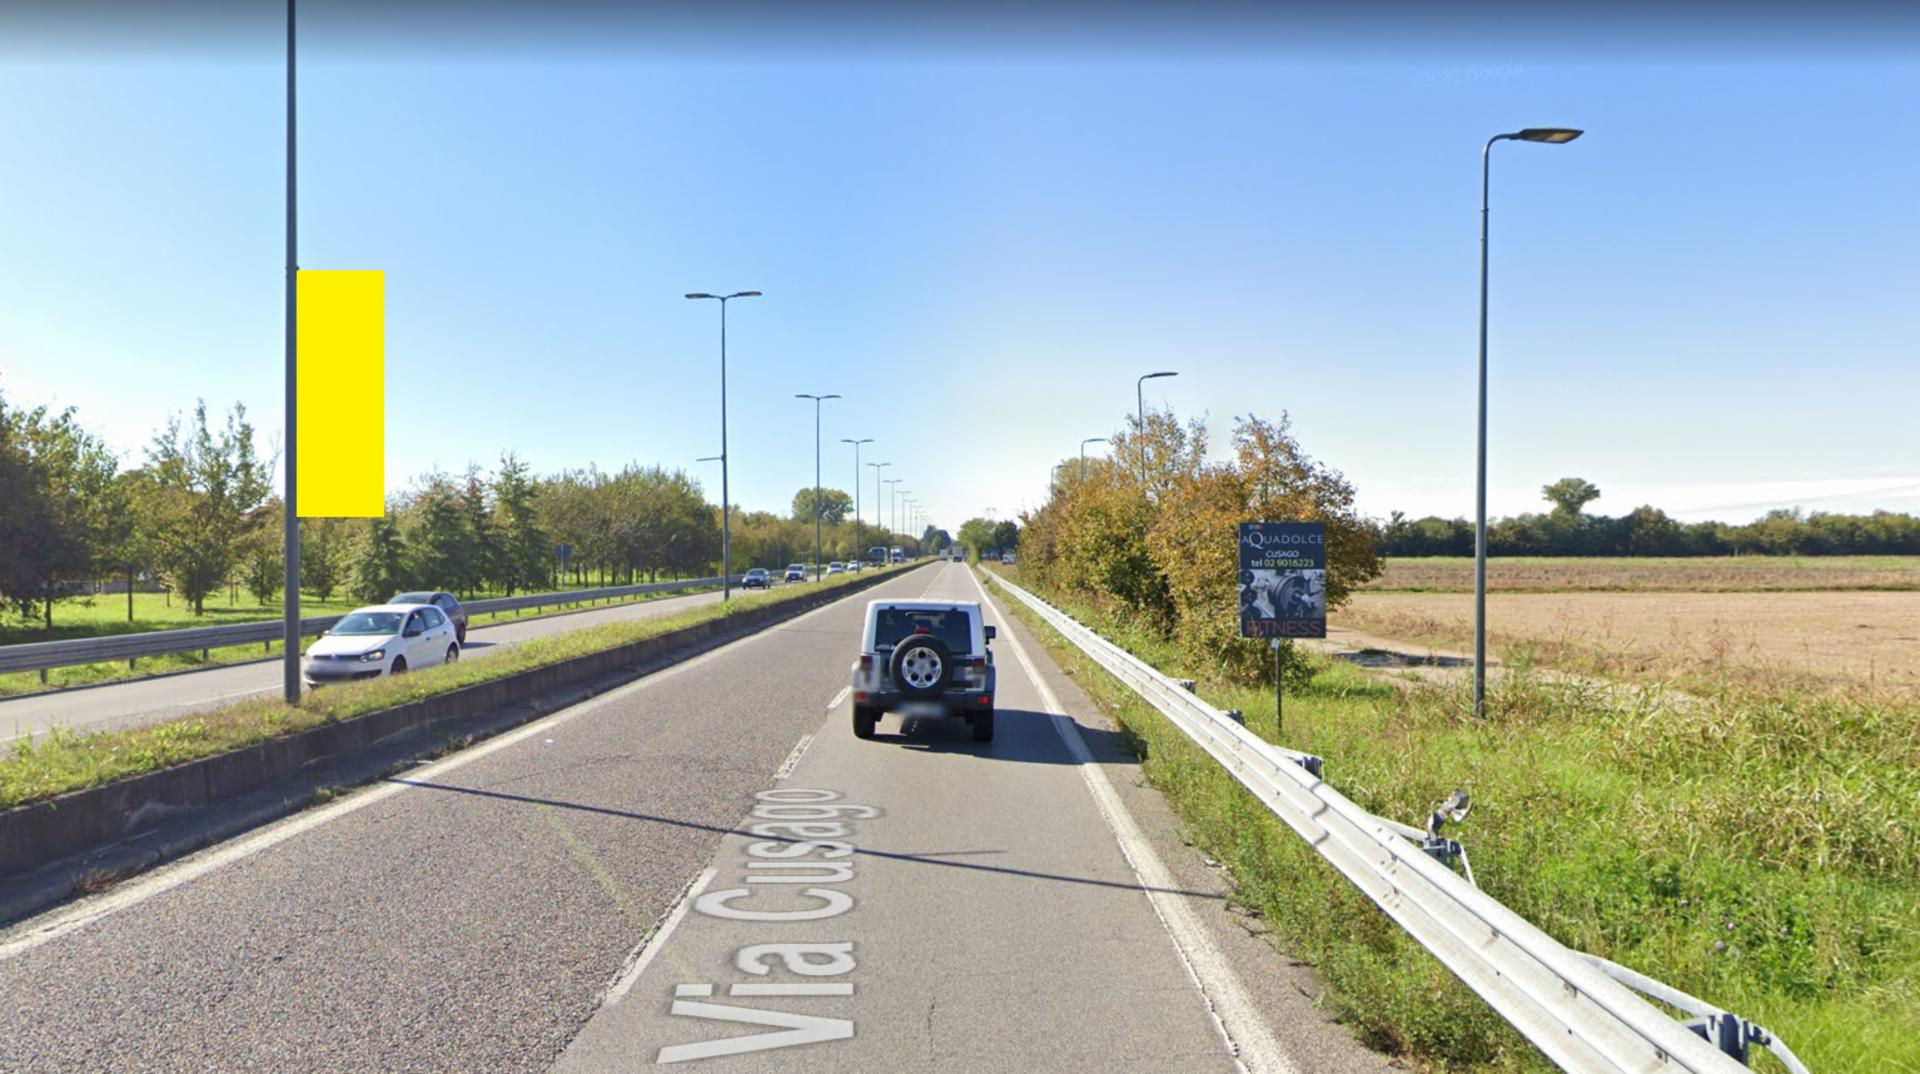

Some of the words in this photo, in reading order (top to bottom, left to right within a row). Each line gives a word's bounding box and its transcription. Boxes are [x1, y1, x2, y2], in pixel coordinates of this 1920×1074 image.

[1241, 532, 1323, 549] AQUADOLCE
[1265, 550, 1299, 559] CUSAGO
[1251, 559, 1263, 568] tel
[1264, 559, 1276, 568] 02
[1277, 559, 1315, 568] 9016223
